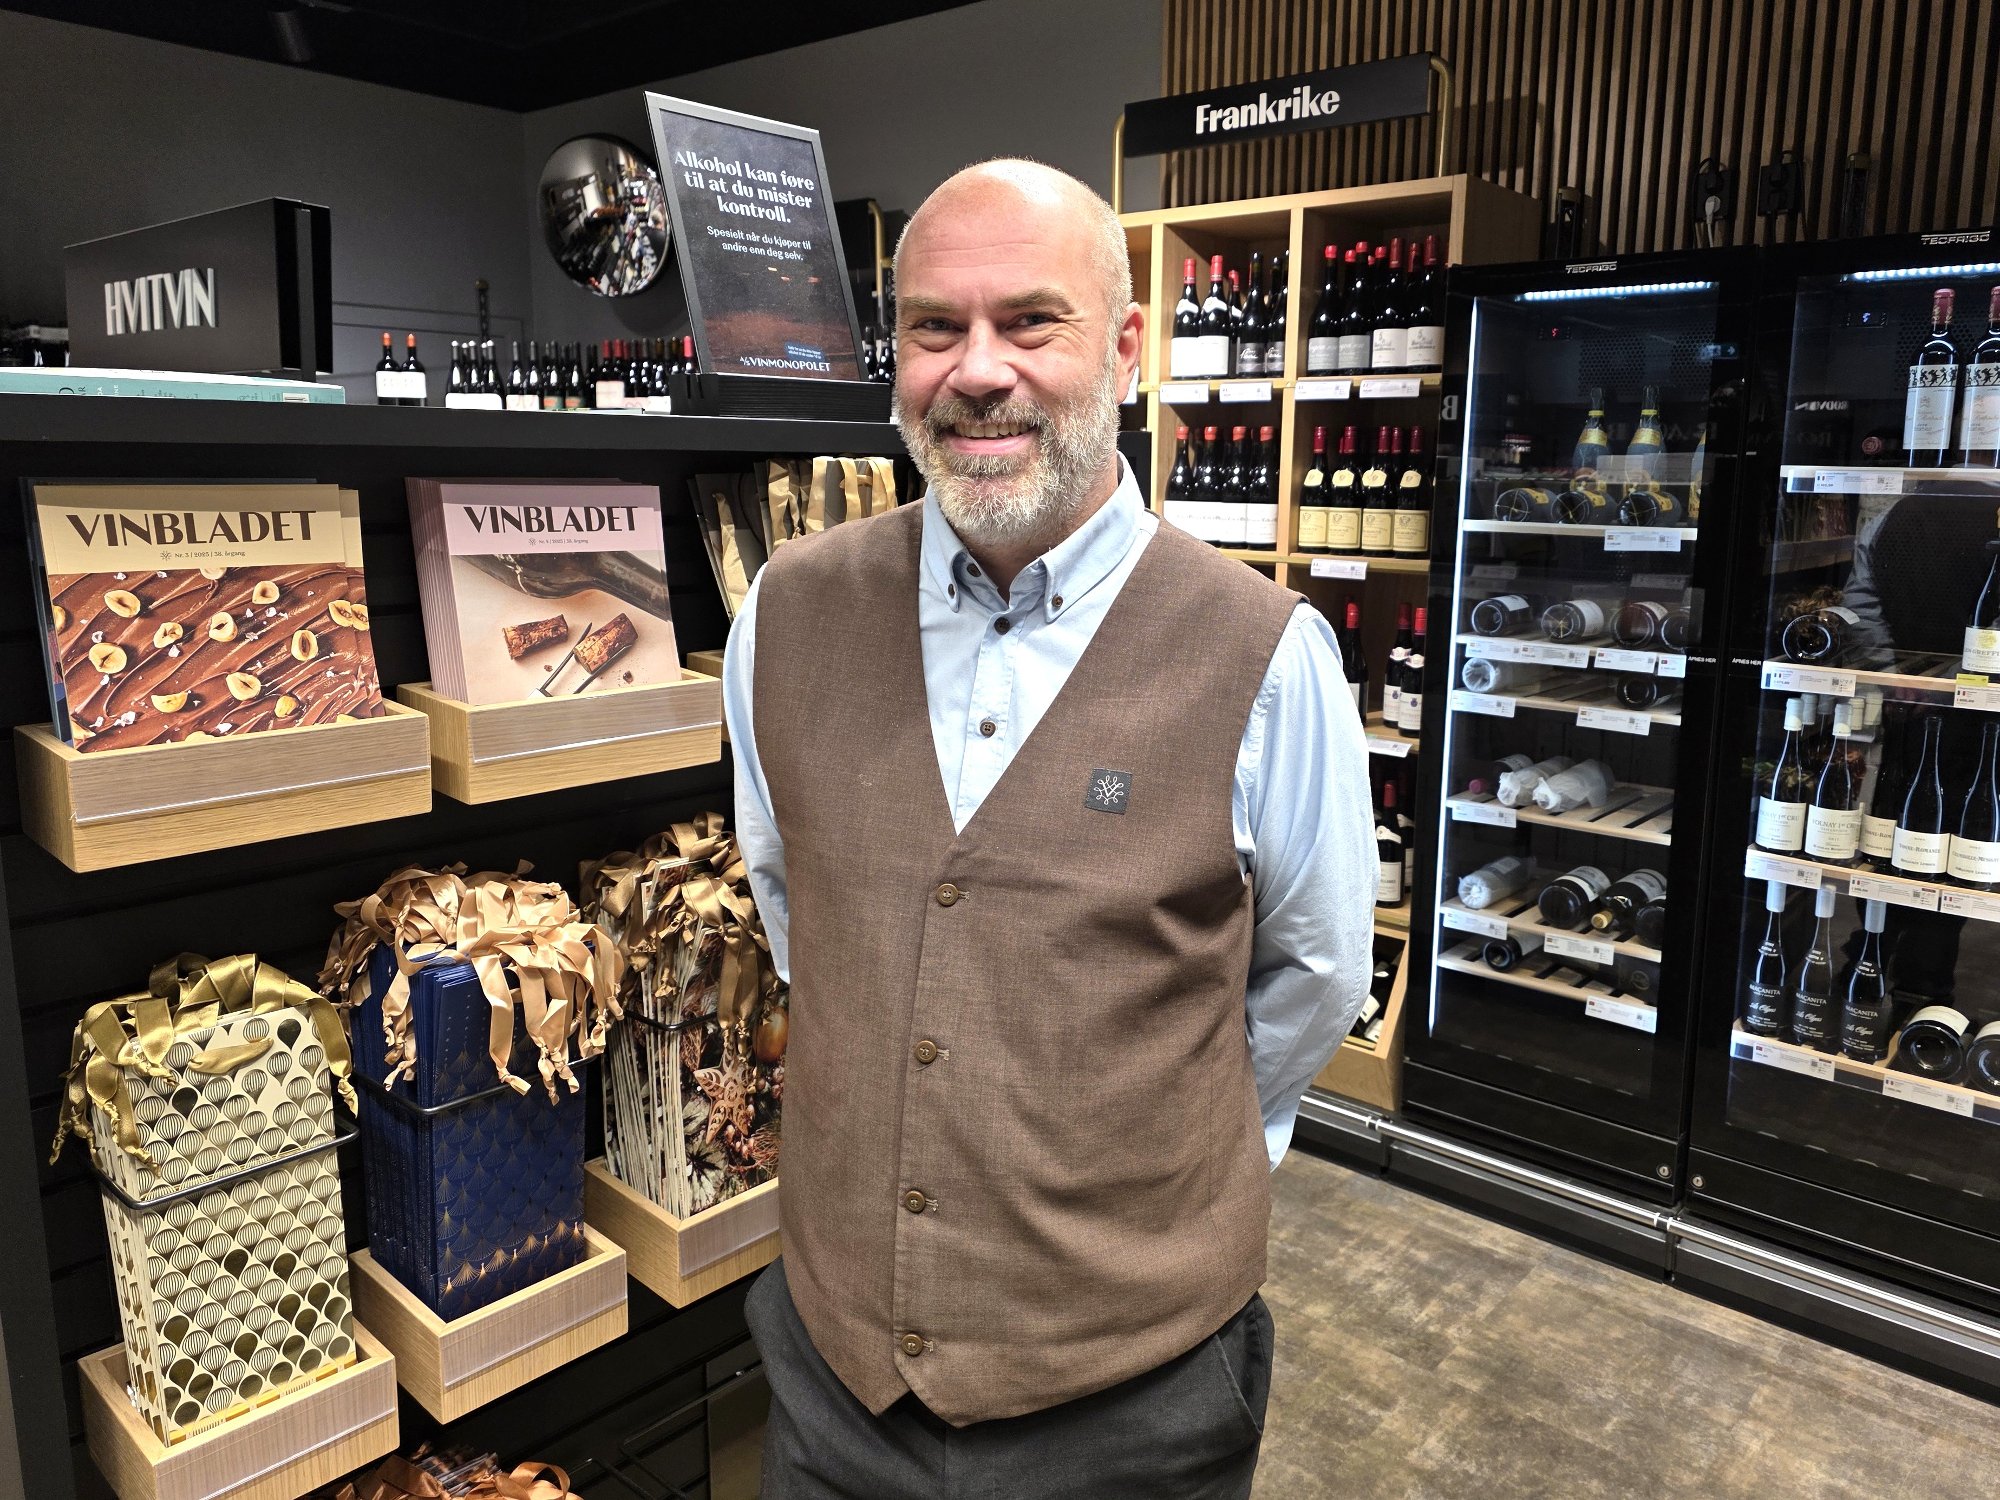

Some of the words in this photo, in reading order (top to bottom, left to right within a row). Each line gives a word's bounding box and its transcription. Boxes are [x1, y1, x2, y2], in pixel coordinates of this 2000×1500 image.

[1195, 86, 1341, 135] Frankrike
[674, 151, 742, 177] Alkohol
[747, 162, 777, 184] kan
[780, 170, 815, 191] føre
[684, 171, 704, 188] til
[708, 176, 729, 193] at
[732, 177, 754, 198] du
[757, 187, 812, 208] mister
[716, 195, 791, 223] kontroll.
[707, 225, 745, 241] Spesielt
[746, 231, 760, 243] når
[762, 232, 773, 244] du
[774, 234, 801, 249] kjøper
[802, 240, 811, 250] til
[722, 241, 748, 253] andre
[749, 245, 765, 256] enn
[766, 246, 783, 260] deg
[784, 249, 804, 261] selv.
[1921, 231, 1990, 245] TECFRIGO
[104, 267, 216, 336] HVITVIN
[749, 357, 830, 371] VINMONOPOLET
[66, 510, 316, 548] VINBLADET
[463, 506, 638, 533] VINBLADET
